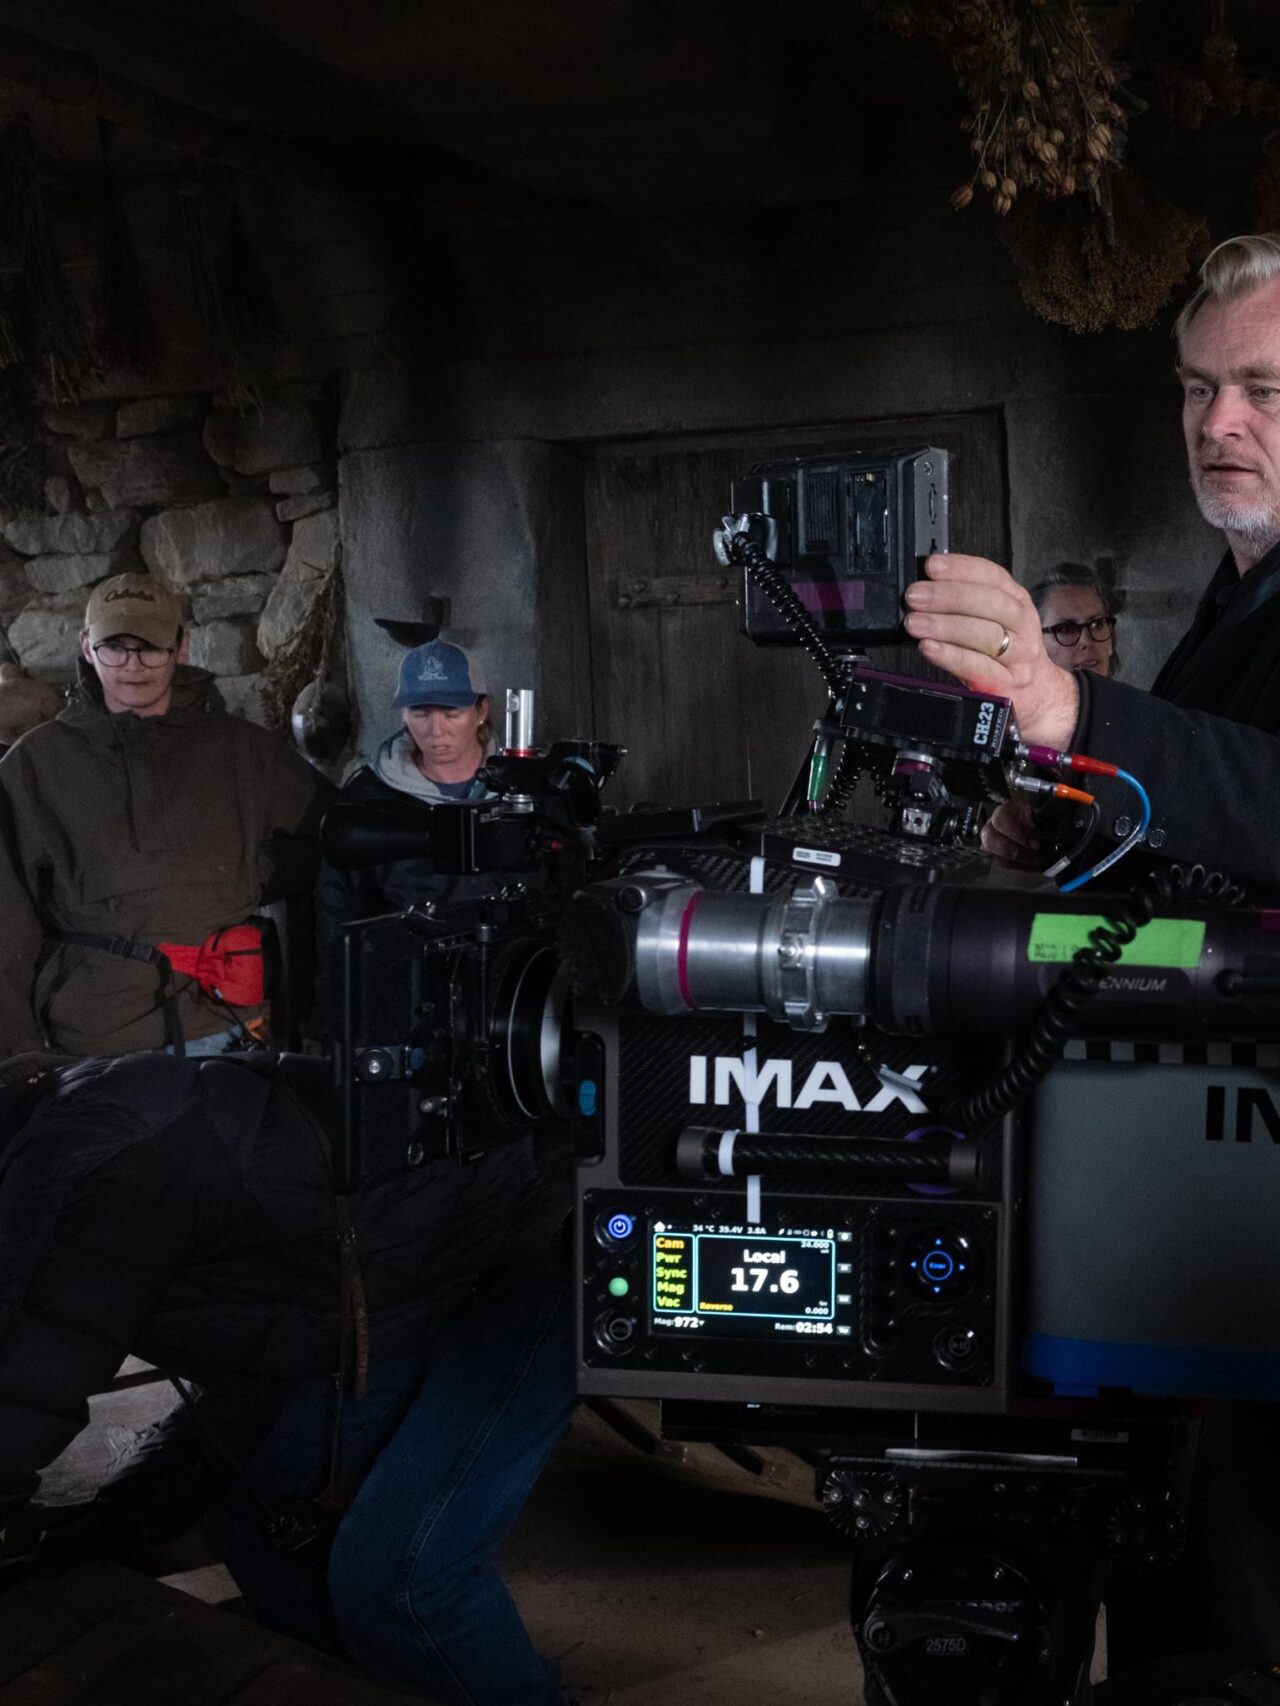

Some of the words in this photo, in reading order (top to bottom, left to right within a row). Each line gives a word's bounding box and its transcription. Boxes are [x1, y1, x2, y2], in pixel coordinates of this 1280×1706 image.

[973, 701, 995, 745] CH:23
[689, 1054, 930, 1115] IMAX
[656, 1237, 685, 1249] Cam
[656, 1252, 682, 1263] Pwr
[743, 1249, 786, 1264] Local
[656, 1266, 687, 1280] Sync
[731, 1267, 800, 1294] 17.6
[657, 1281, 685, 1295] Mag
[657, 1296, 680, 1308] Vac
[926, 1637, 967, 1655] 2575D
